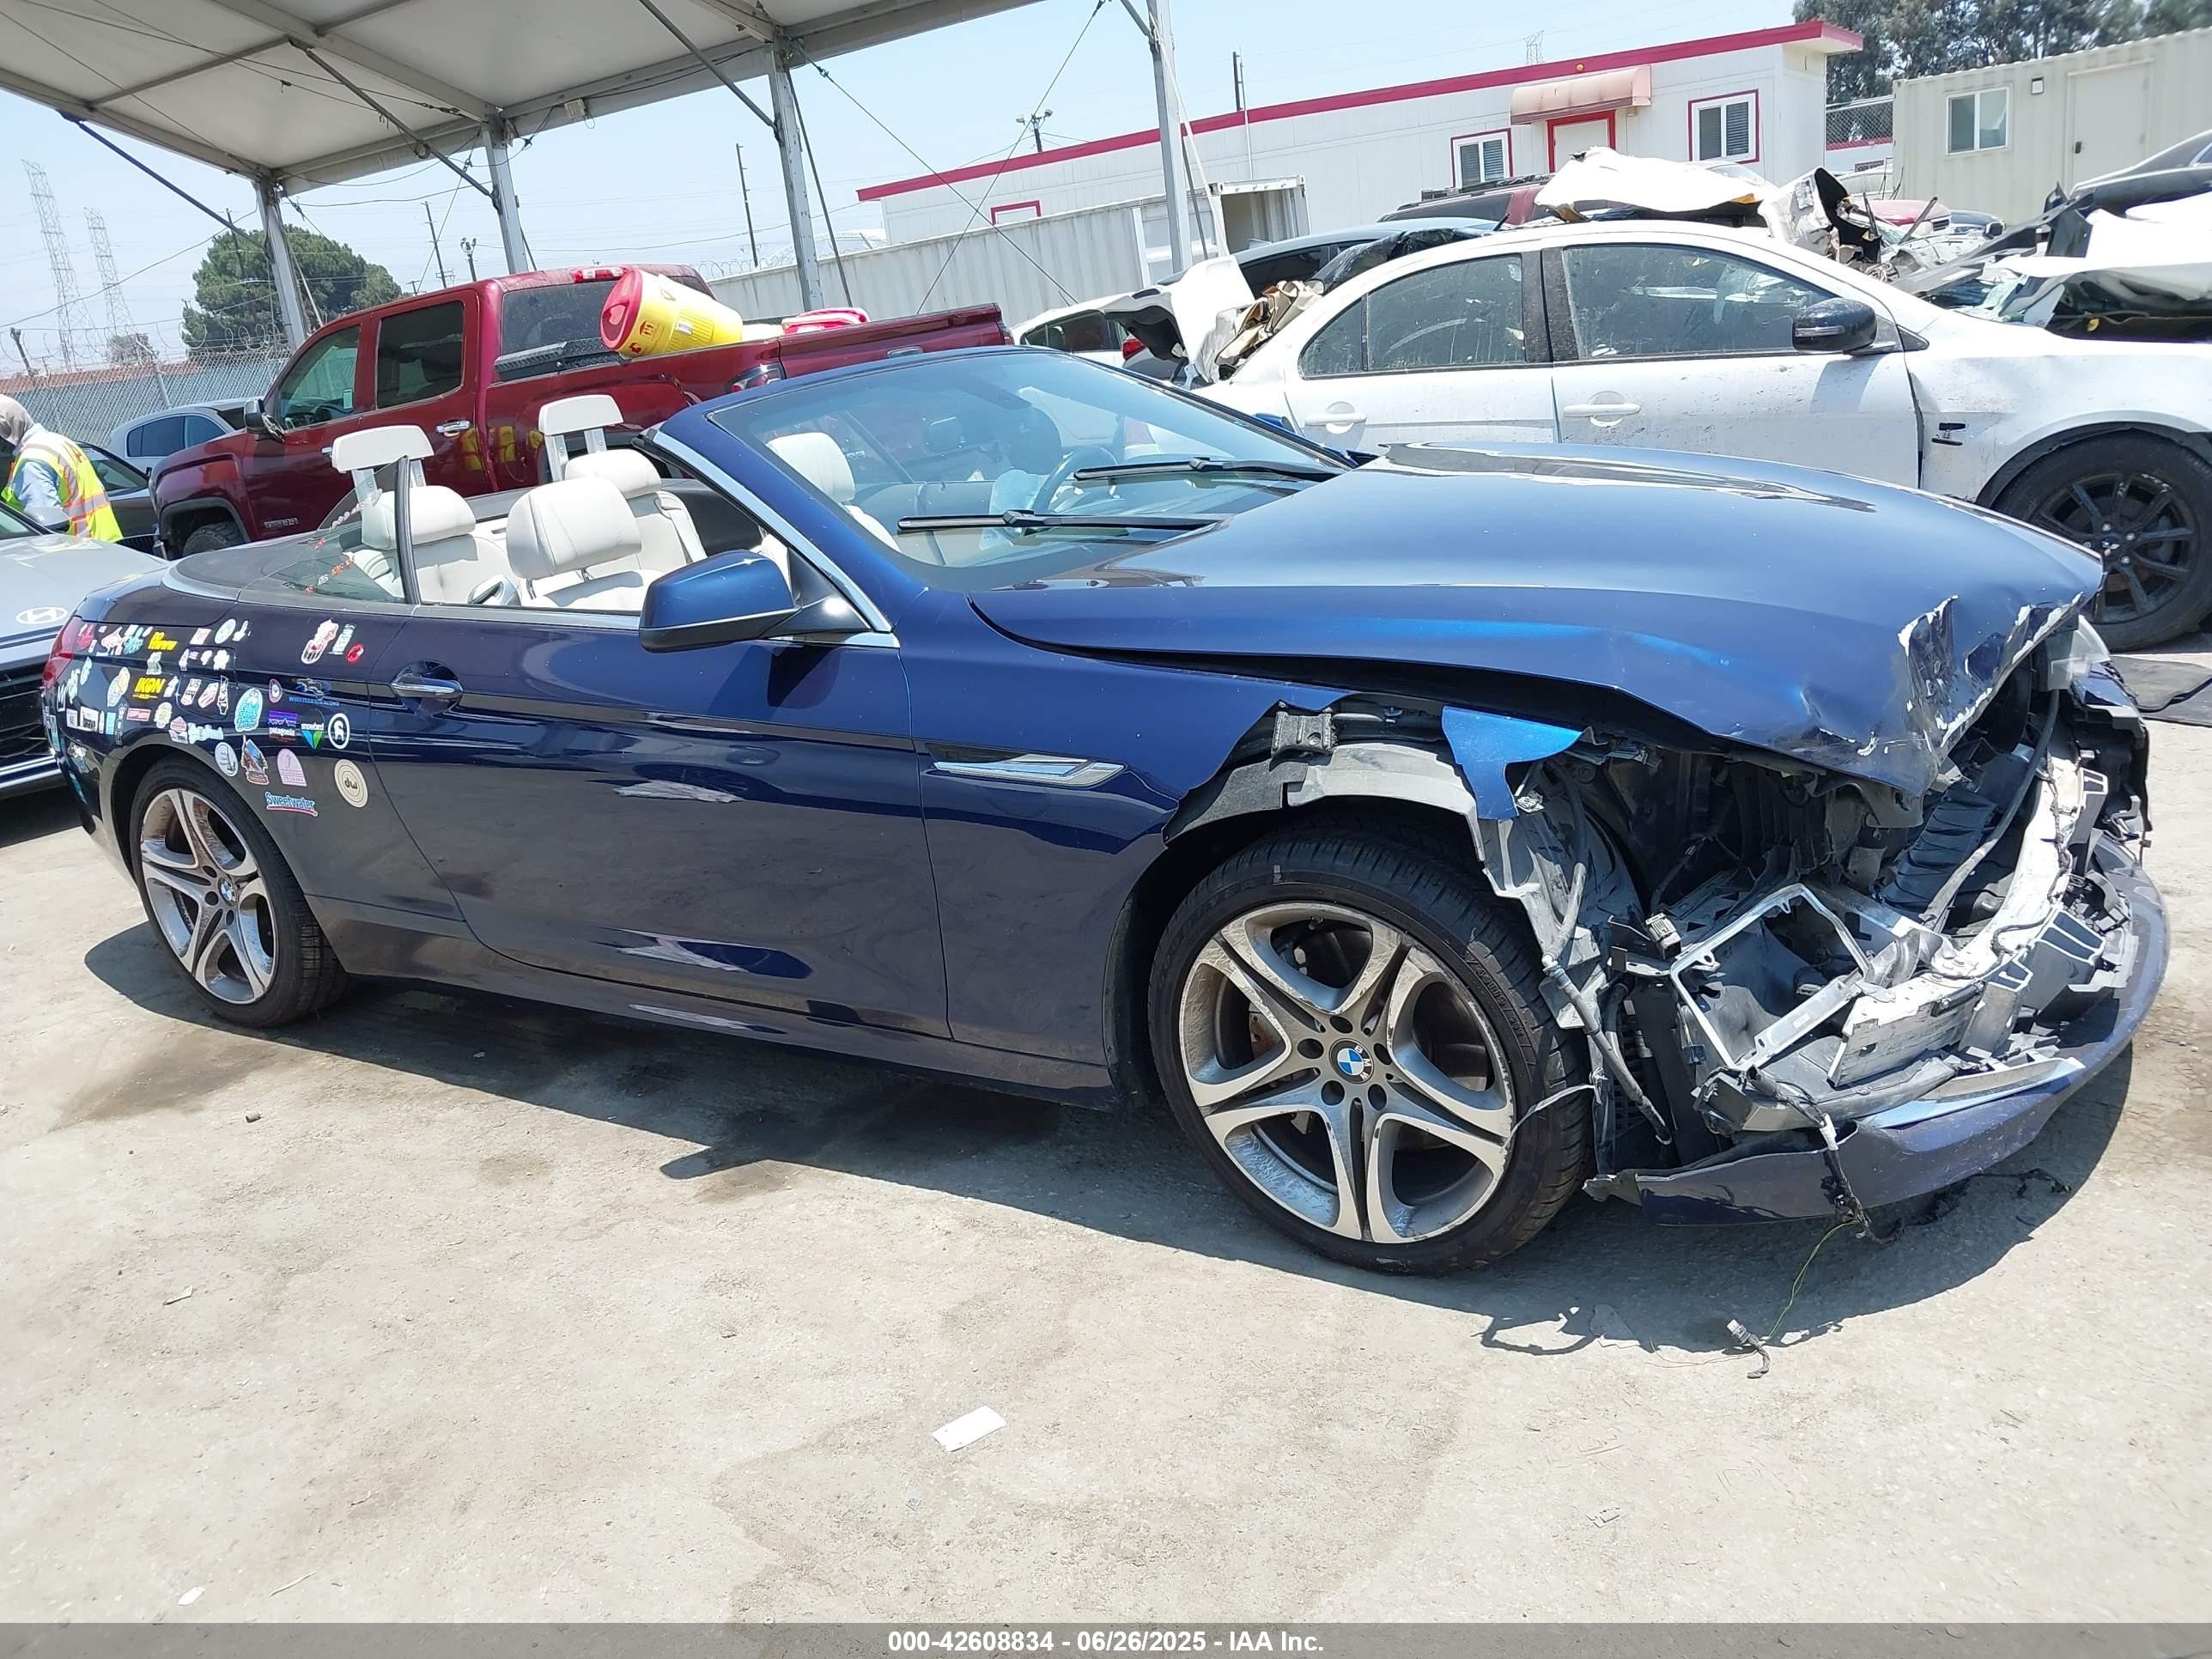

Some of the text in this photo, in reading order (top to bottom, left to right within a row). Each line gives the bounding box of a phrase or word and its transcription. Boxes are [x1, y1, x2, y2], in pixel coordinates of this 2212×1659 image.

[135, 678, 166, 693] IKON
[269, 726, 295, 737] patagonia
[301, 722, 325, 731] snowbird
[265, 793, 315, 811] Sweetwater
[1354, 1044, 1371, 1082] BMW
